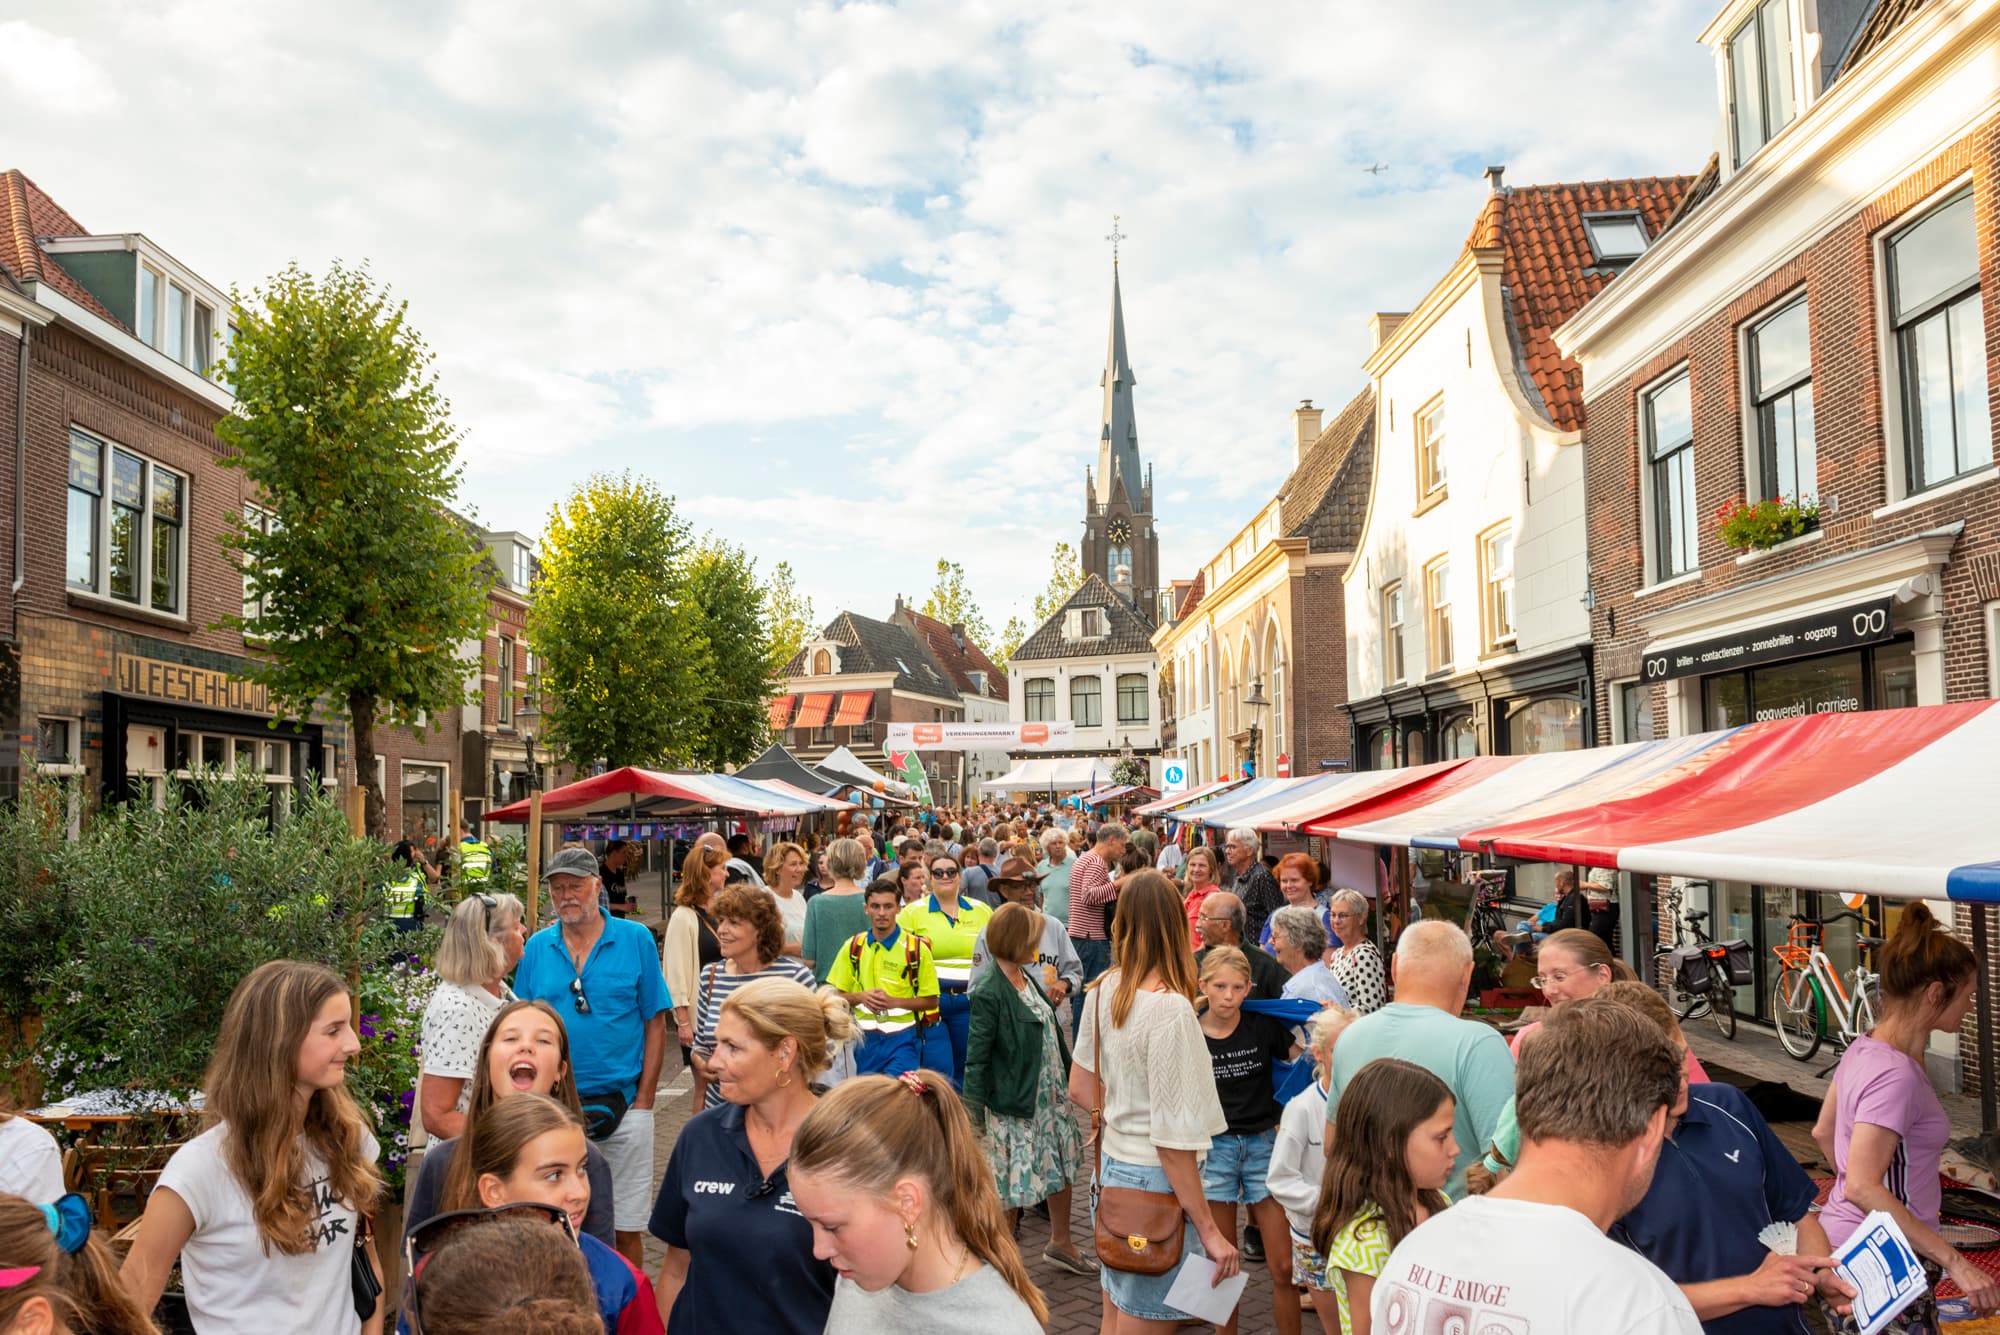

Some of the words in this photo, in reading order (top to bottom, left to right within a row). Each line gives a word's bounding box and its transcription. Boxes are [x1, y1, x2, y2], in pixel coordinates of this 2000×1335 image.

[1676, 656, 1693, 668] brillen
[1701, 645, 1744, 662] contactlenzen
[1752, 634, 1793, 652] zonnebrillen
[1804, 625, 1837, 642] oogzorg
[1816, 697, 1858, 714] carriere
[945, 730, 1015, 738] VERENIGINGENMARKT
[693, 1180, 735, 1195] crew
[1407, 1263, 1452, 1296] BLUE
[1452, 1279, 1510, 1307] RIDGE
